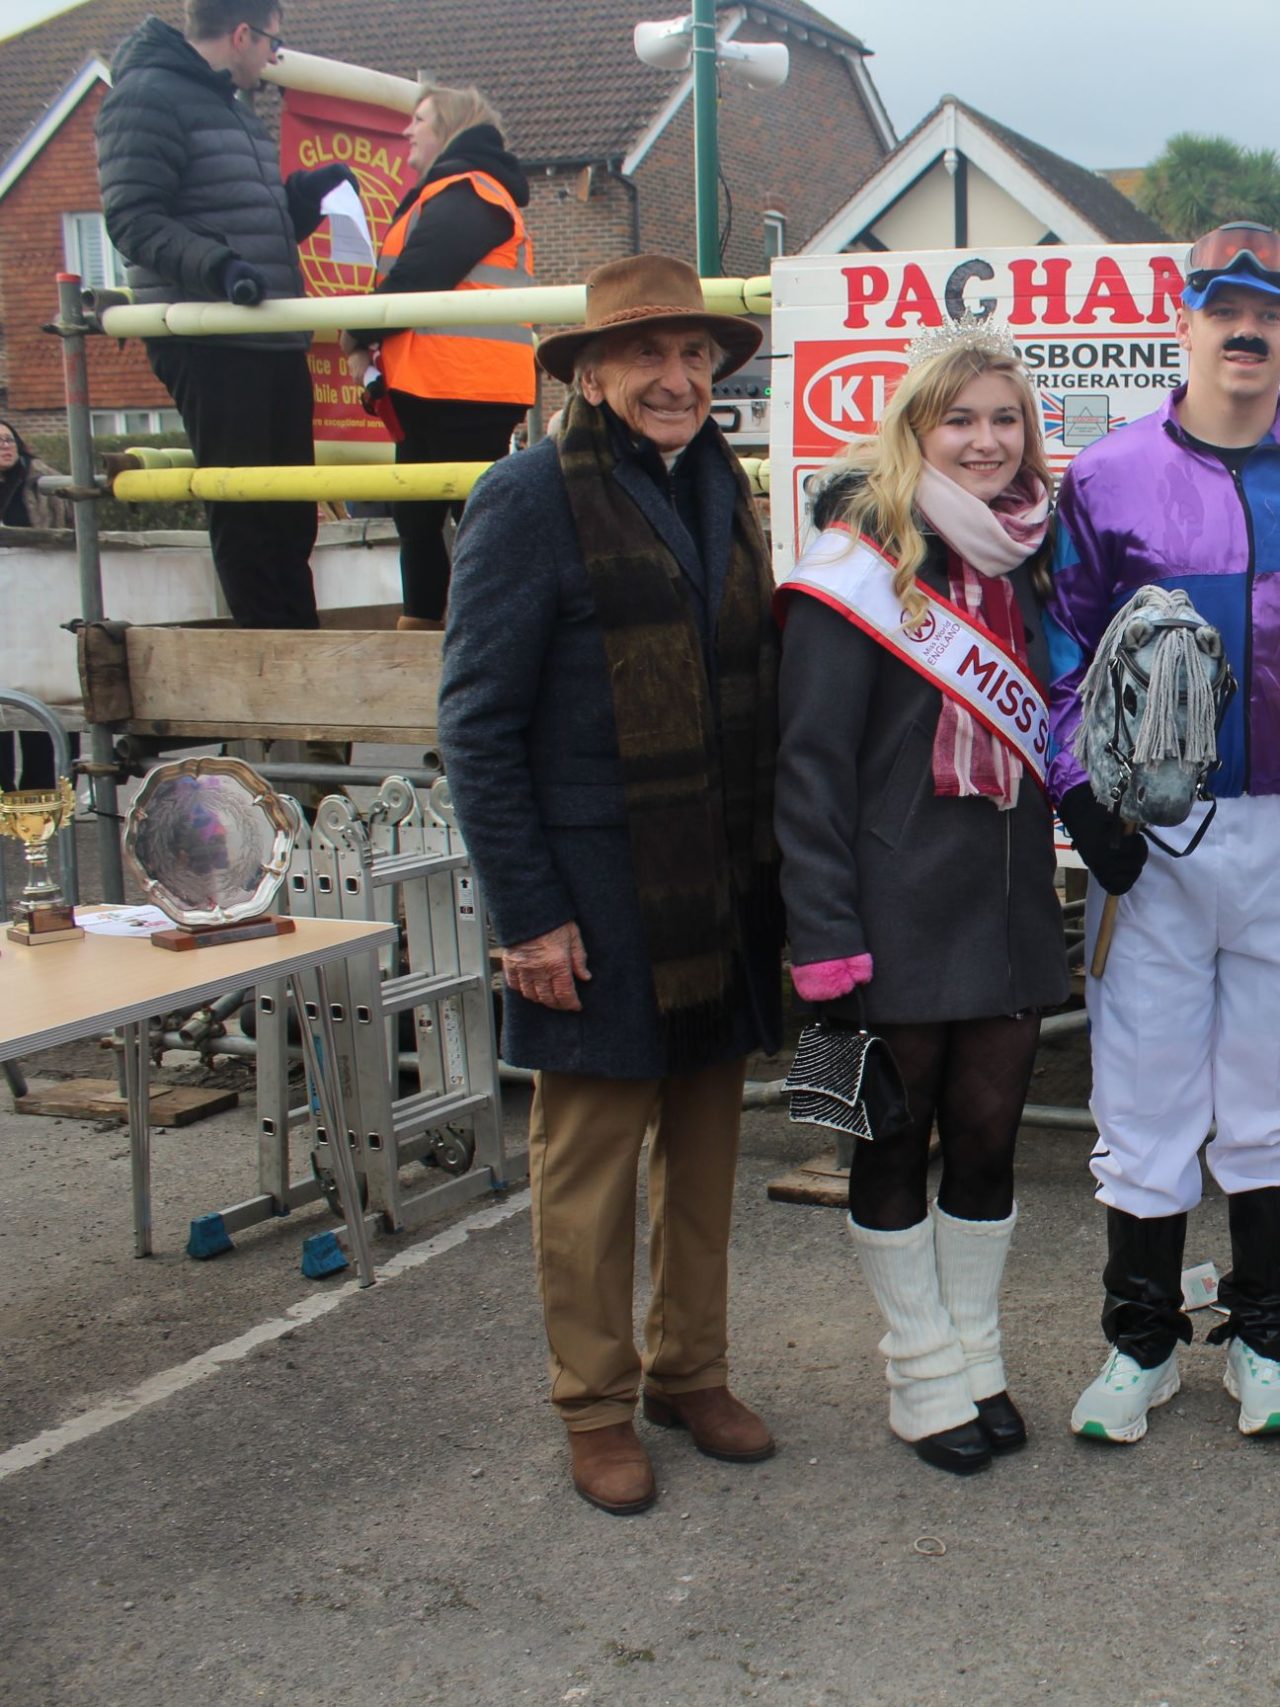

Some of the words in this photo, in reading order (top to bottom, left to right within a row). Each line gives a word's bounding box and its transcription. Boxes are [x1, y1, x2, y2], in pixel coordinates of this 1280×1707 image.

[299, 132, 403, 186] GLOBAL
[1013, 343, 1181, 369] SBORNE
[830, 375, 884, 422] KI
[922, 642, 936, 656] Miss
[934, 620, 952, 642] World
[927, 623, 960, 666] ENGLAND
[957, 644, 1037, 733] MISS
